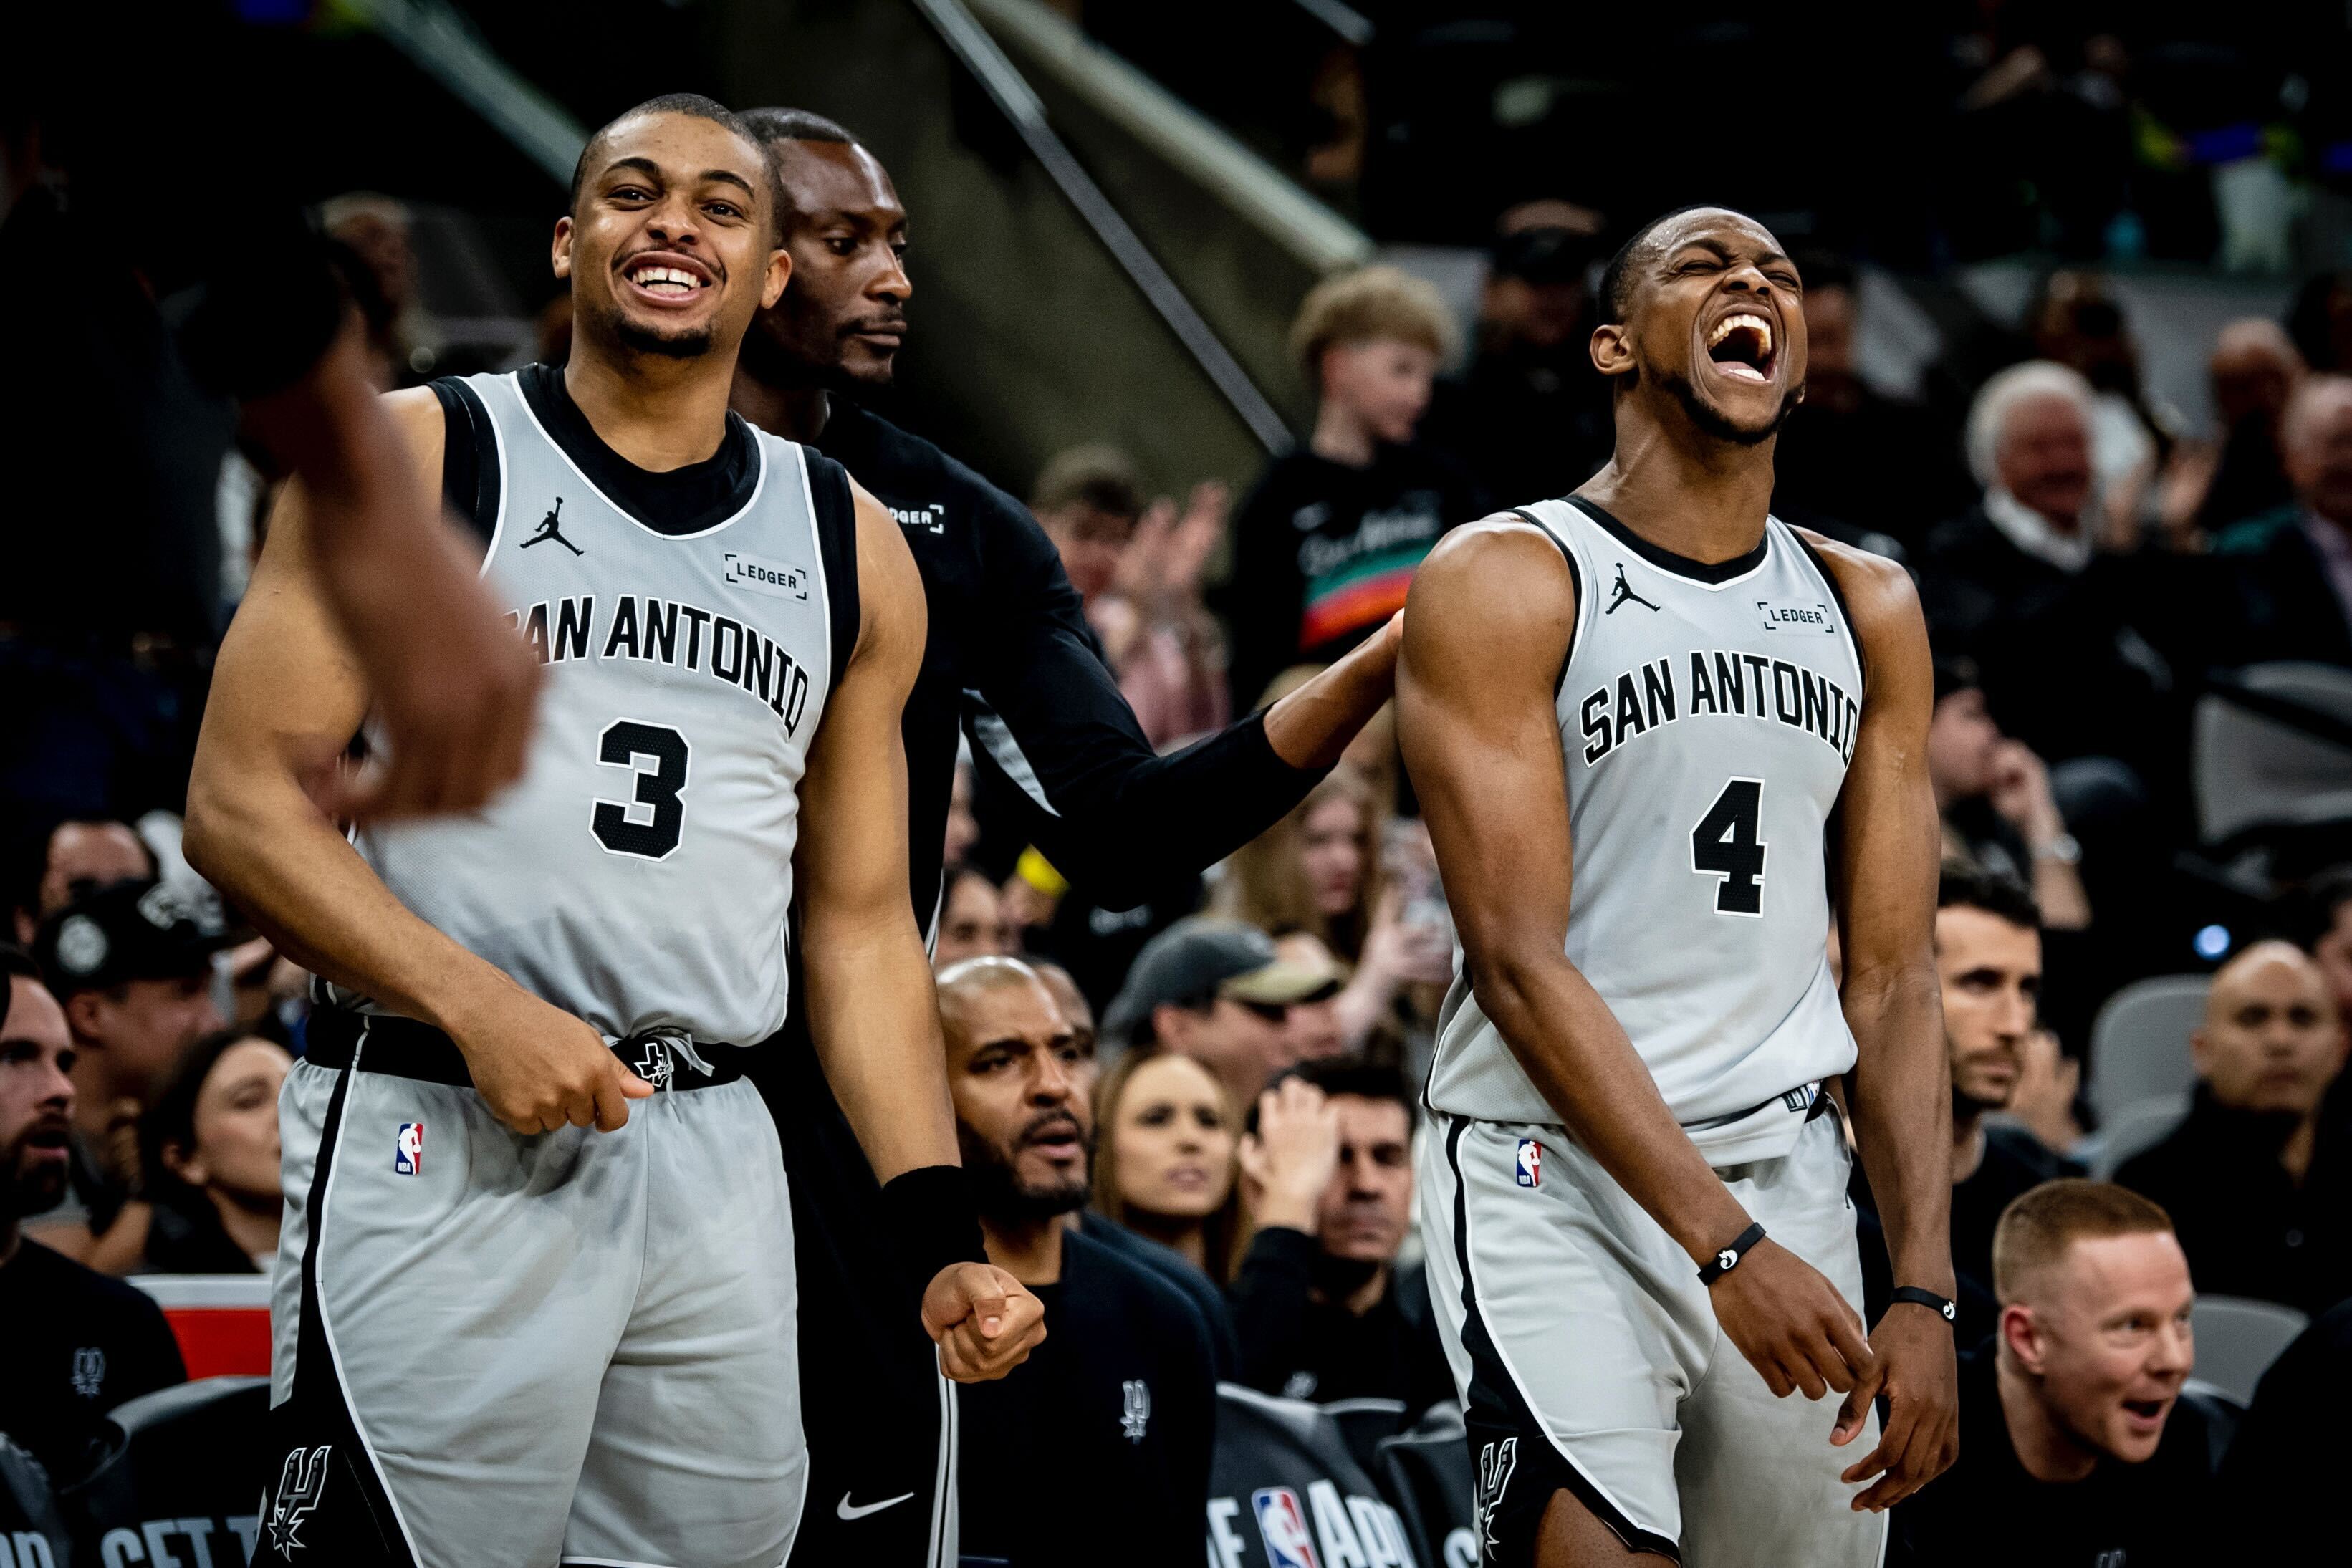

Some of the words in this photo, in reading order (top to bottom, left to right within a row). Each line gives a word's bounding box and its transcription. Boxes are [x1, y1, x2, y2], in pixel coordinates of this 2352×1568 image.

[736, 562, 797, 589] LEDGER
[1770, 608, 1823, 625] LEDGER
[503, 594, 596, 667] AN
[600, 594, 809, 742] ANTONIO
[1579, 655, 1679, 769] SAN
[1688, 650, 1860, 772] ANTONIO
[588, 716, 691, 862] 3
[1689, 775, 1768, 918] 4
